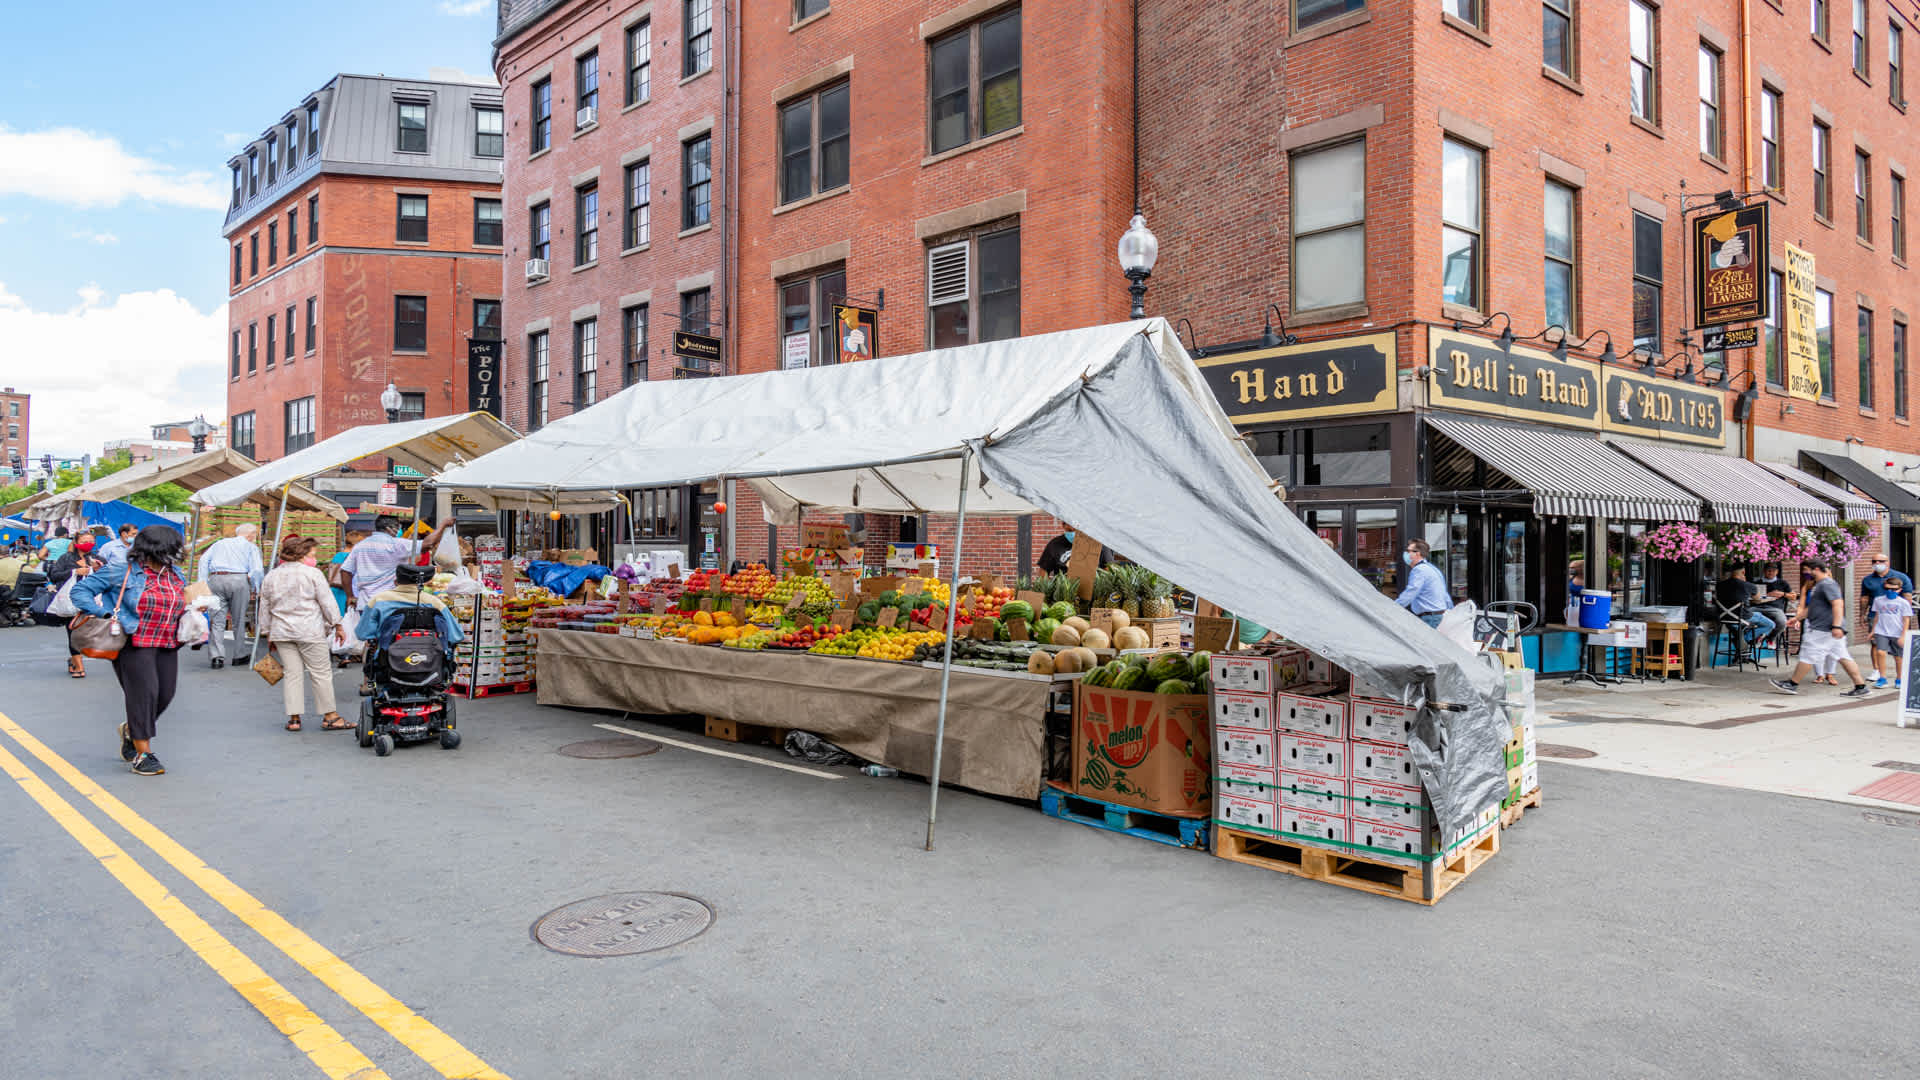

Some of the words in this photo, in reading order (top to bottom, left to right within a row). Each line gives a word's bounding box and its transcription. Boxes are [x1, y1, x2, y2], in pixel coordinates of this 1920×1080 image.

[1710, 270, 1753, 286] BELL
[1720, 283, 1753, 295] HAND
[1712, 290, 1753, 304] TAVERN
[478, 355, 493, 409] POIN
[1230, 360, 1345, 404] Hand
[1450, 349, 1498, 393] Bell
[1507, 363, 1528, 397] in
[1536, 367, 1590, 409] Hand
[1679, 397, 1716, 430] 1795
[1109, 724, 1143, 748] melon
[590, 909, 698, 947] BOSTON
